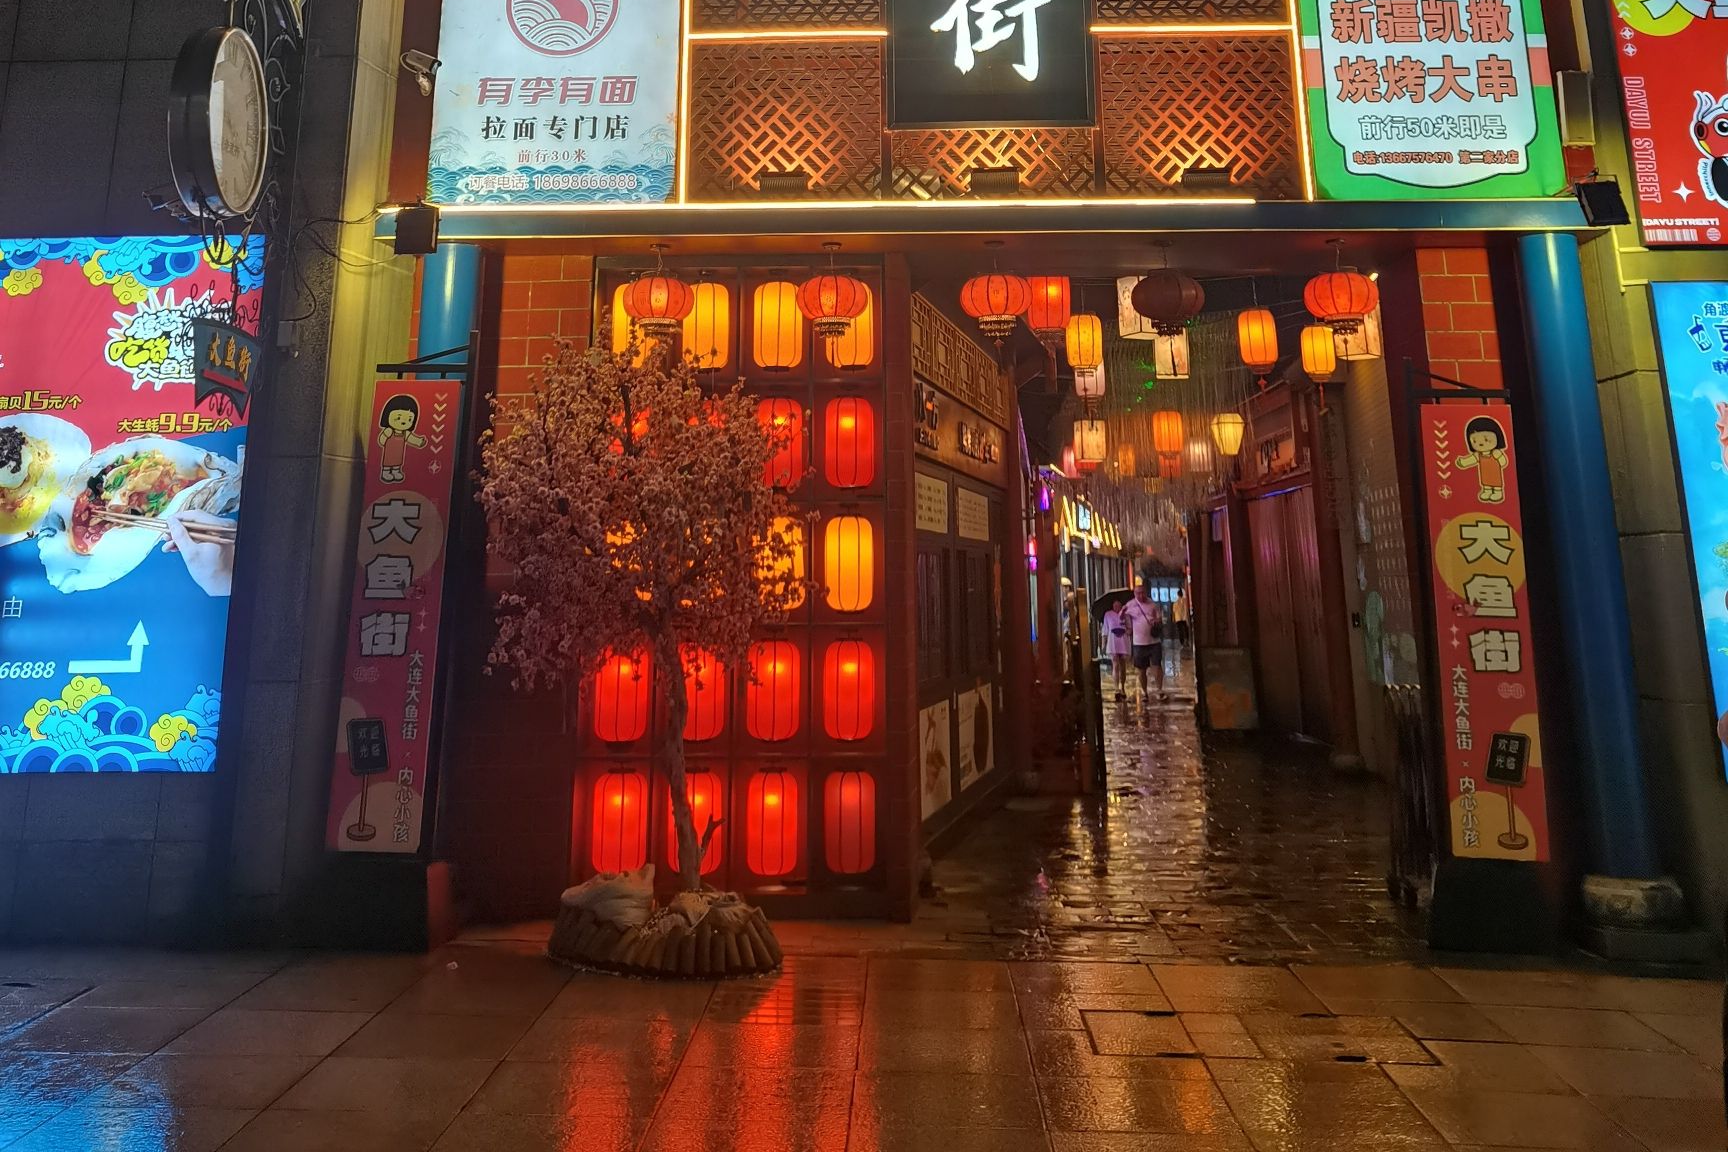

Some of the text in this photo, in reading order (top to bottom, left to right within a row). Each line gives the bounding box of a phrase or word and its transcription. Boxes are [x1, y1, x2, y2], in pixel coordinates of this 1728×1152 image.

[477, 75, 638, 106] 有李有面
[1334, 54, 1519, 103] 烧烤大串
[481, 115, 629, 141] 拉面专门店
[1358, 114, 1507, 141] 前行50米即是
[518, 148, 587, 163] 前行30米
[1458, 149, 1519, 164] 第二家分店
[1632, 137, 1662, 204] STREET
[533, 174, 637, 190] 18698666888
[117, 413, 233, 433] 大生蚝9.9元/个
[360, 499, 422, 657] 大鱼街
[2, 596, 23, 618] 由
[1458, 520, 1521, 673] 大鱼街
[0, 661, 56, 679] 66888
[402, 650, 424, 741] 大连大鱼街
[1452, 664, 1473, 751] 大连大鱼街
[392, 767, 414, 843] 内心小孩
[1459, 776, 1480, 848] 内心小孩
